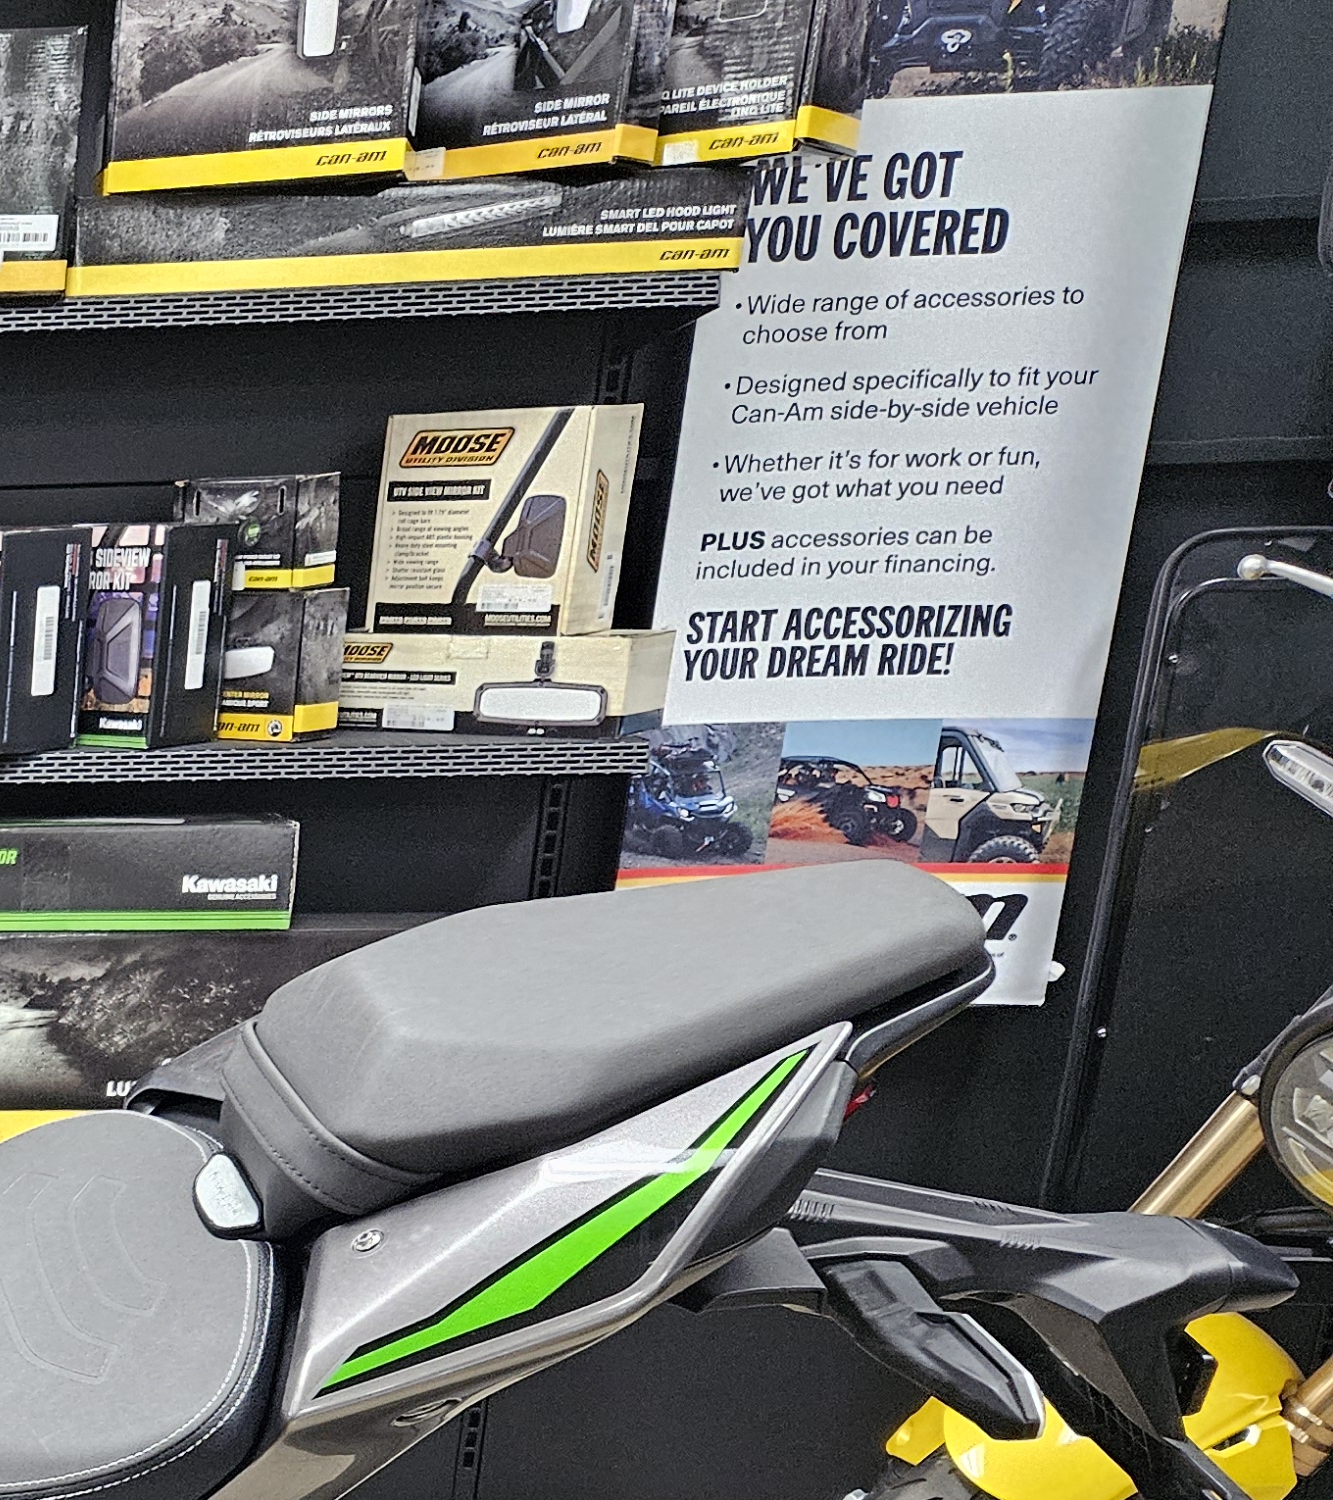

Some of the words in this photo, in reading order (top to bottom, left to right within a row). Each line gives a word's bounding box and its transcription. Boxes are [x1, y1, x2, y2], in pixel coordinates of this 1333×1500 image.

[670, 86, 695, 99] LITE
[697, 81, 739, 96] DEVICE
[740, 75, 788, 90] HOLDER
[309, 109, 337, 122] SIDE
[339, 104, 393, 120] MIRRORS
[534, 100, 563, 114] SIDE
[563, 93, 611, 110] MIRROR
[248, 125, 333, 143] RÉTROVISEURS
[335, 120, 391, 136] LATÉRAUX
[483, 116, 559, 136] RÉTROVISEUR
[560, 110, 607, 127] LATÉRAL
[537, 141, 602, 159] can-am
[709, 132, 778, 150] can-am
[316, 150, 387, 166] can-am
[753, 153, 873, 206] WE'VE
[883, 151, 964, 201] GOT
[600, 208, 640, 219] SMART
[643, 207, 665, 218] LED
[666, 206, 700, 217] HOOD
[703, 205, 736, 216] LIGHT
[543, 223, 593, 237] LUMIÈRE
[595, 223, 635, 235] SMART
[637, 222, 660, 233] DEL
[661, 221, 694, 232] POUR
[697, 219, 734, 231] CAPOT
[746, 214, 822, 263] YOU
[834, 208, 1010, 260] COVERED
[659, 248, 731, 261] can-am
[748, 294, 805, 315] Wide
[812, 297, 878, 316] range
[885, 289, 910, 310] of
[914, 286, 1055, 309] accessories
[1062, 286, 1085, 305] to
[743, 325, 827, 345] choose
[835, 321, 887, 340] from
[736, 372, 846, 398] Designed
[852, 368, 984, 395] specifically
[989, 371, 1011, 388] to
[1018, 366, 1040, 387] fit
[1045, 369, 1099, 391] your
[732, 402, 823, 424] Can-Am
[831, 397, 970, 424] side-by-side
[976, 396, 1059, 417] vehicle
[410, 432, 507, 456] MOOSE
[405, 456, 444, 465] UTILITY
[445, 454, 495, 464] DIVISION
[725, 452, 823, 474] Whether
[828, 449, 861, 470] it's
[867, 448, 900, 470] for
[905, 447, 961, 468] work
[967, 450, 993, 467] or
[997, 446, 1041, 470] fun,
[407, 486, 424, 497] SIDE
[425, 486, 444, 496] VIEW
[444, 485, 472, 496] MIRROR
[472, 485, 486, 495] KIT
[719, 482, 786, 502] we've
[792, 480, 829, 504] got
[835, 478, 891, 498] what
[896, 480, 939, 501] you
[945, 475, 1004, 496] need
[588, 481, 607, 563] MOOSE
[700, 530, 766, 552] PLUS
[771, 526, 909, 548] accessories
[915, 529, 957, 546] can
[964, 525, 993, 544] be
[95, 548, 151, 568] SIDEVIEW
[695, 557, 795, 580] included
[801, 556, 821, 577] in
[826, 558, 879, 580] your
[884, 553, 996, 576] financing.
[113, 571, 131, 591] KIT
[686, 608, 779, 644] START
[782, 603, 1014, 641] ACCESSORIZING
[683, 647, 760, 681] YOUR
[766, 643, 870, 678] DREAM
[877, 642, 955, 676] RIDE!
[217, 722, 260, 732] an-am
[181, 874, 278, 893] Kawasaki
[106, 1080, 137, 1097] LU
